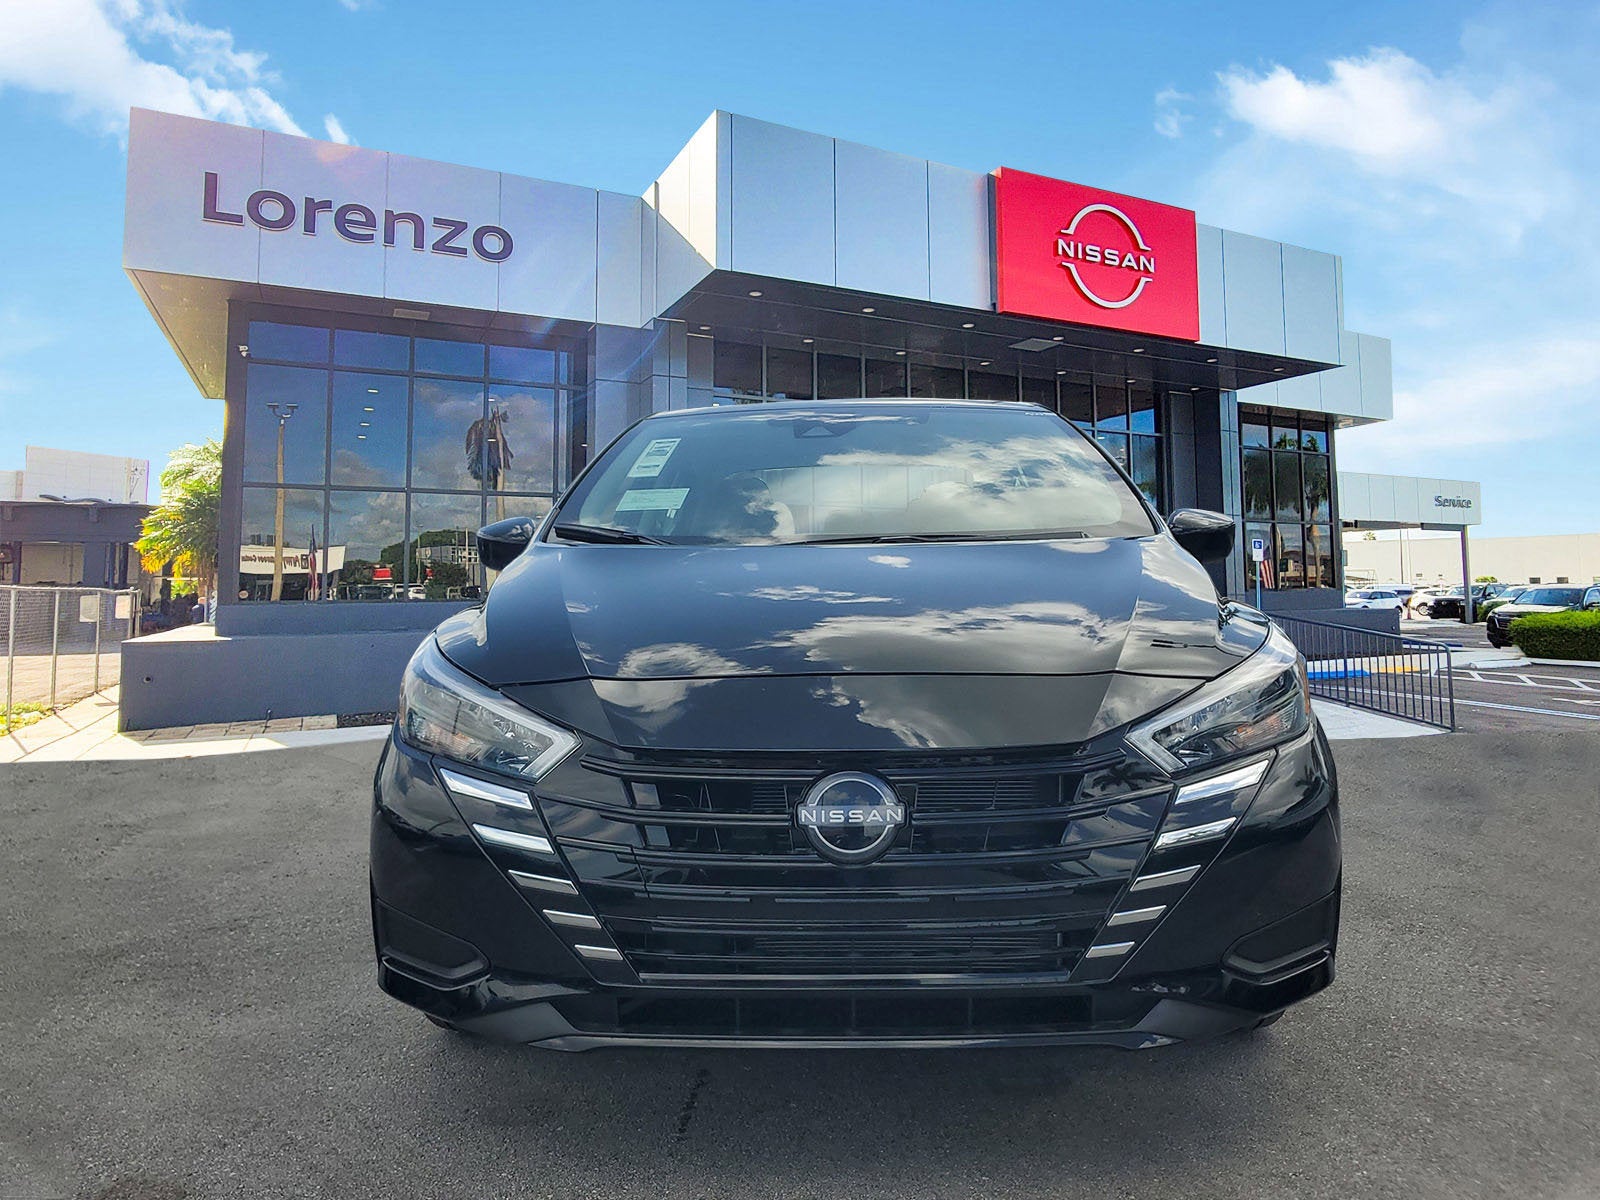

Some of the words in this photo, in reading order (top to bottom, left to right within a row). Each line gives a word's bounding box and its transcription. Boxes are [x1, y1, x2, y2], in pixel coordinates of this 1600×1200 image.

[202, 171, 514, 262] Lorenzo
[1057, 238, 1155, 273] NISSAN
[1434, 495, 1472, 509] Service
[800, 808, 902, 823] NISSAN
